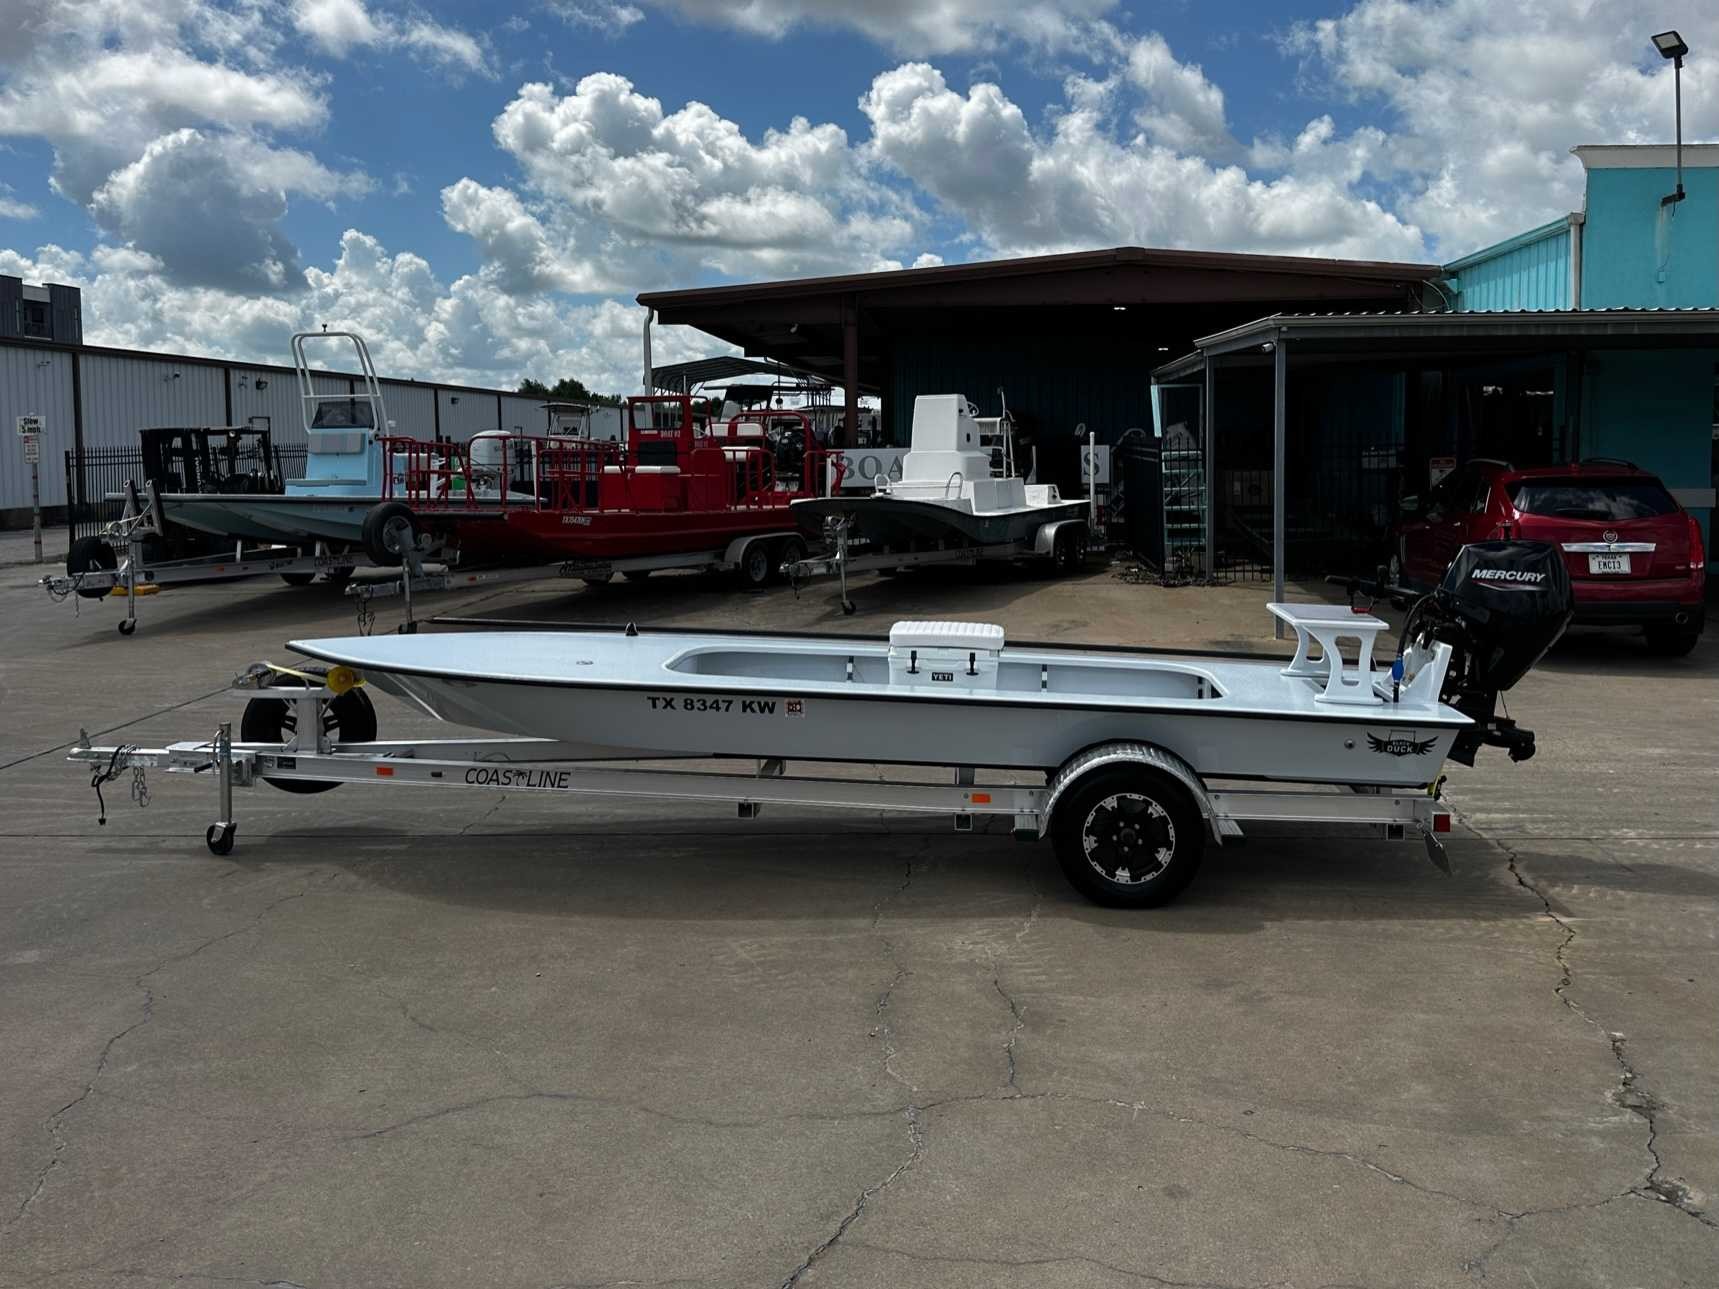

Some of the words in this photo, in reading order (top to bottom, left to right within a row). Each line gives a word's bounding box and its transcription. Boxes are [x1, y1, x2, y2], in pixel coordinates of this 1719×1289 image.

[23, 417, 39, 425] Slow
[1471, 568, 1546, 583] MERCURY
[933, 673, 952, 681] YETI
[646, 696, 677, 711] TX
[683, 698, 734, 713] 8347
[741, 700, 777, 714] KW
[1386, 745, 1414, 753] DUCK
